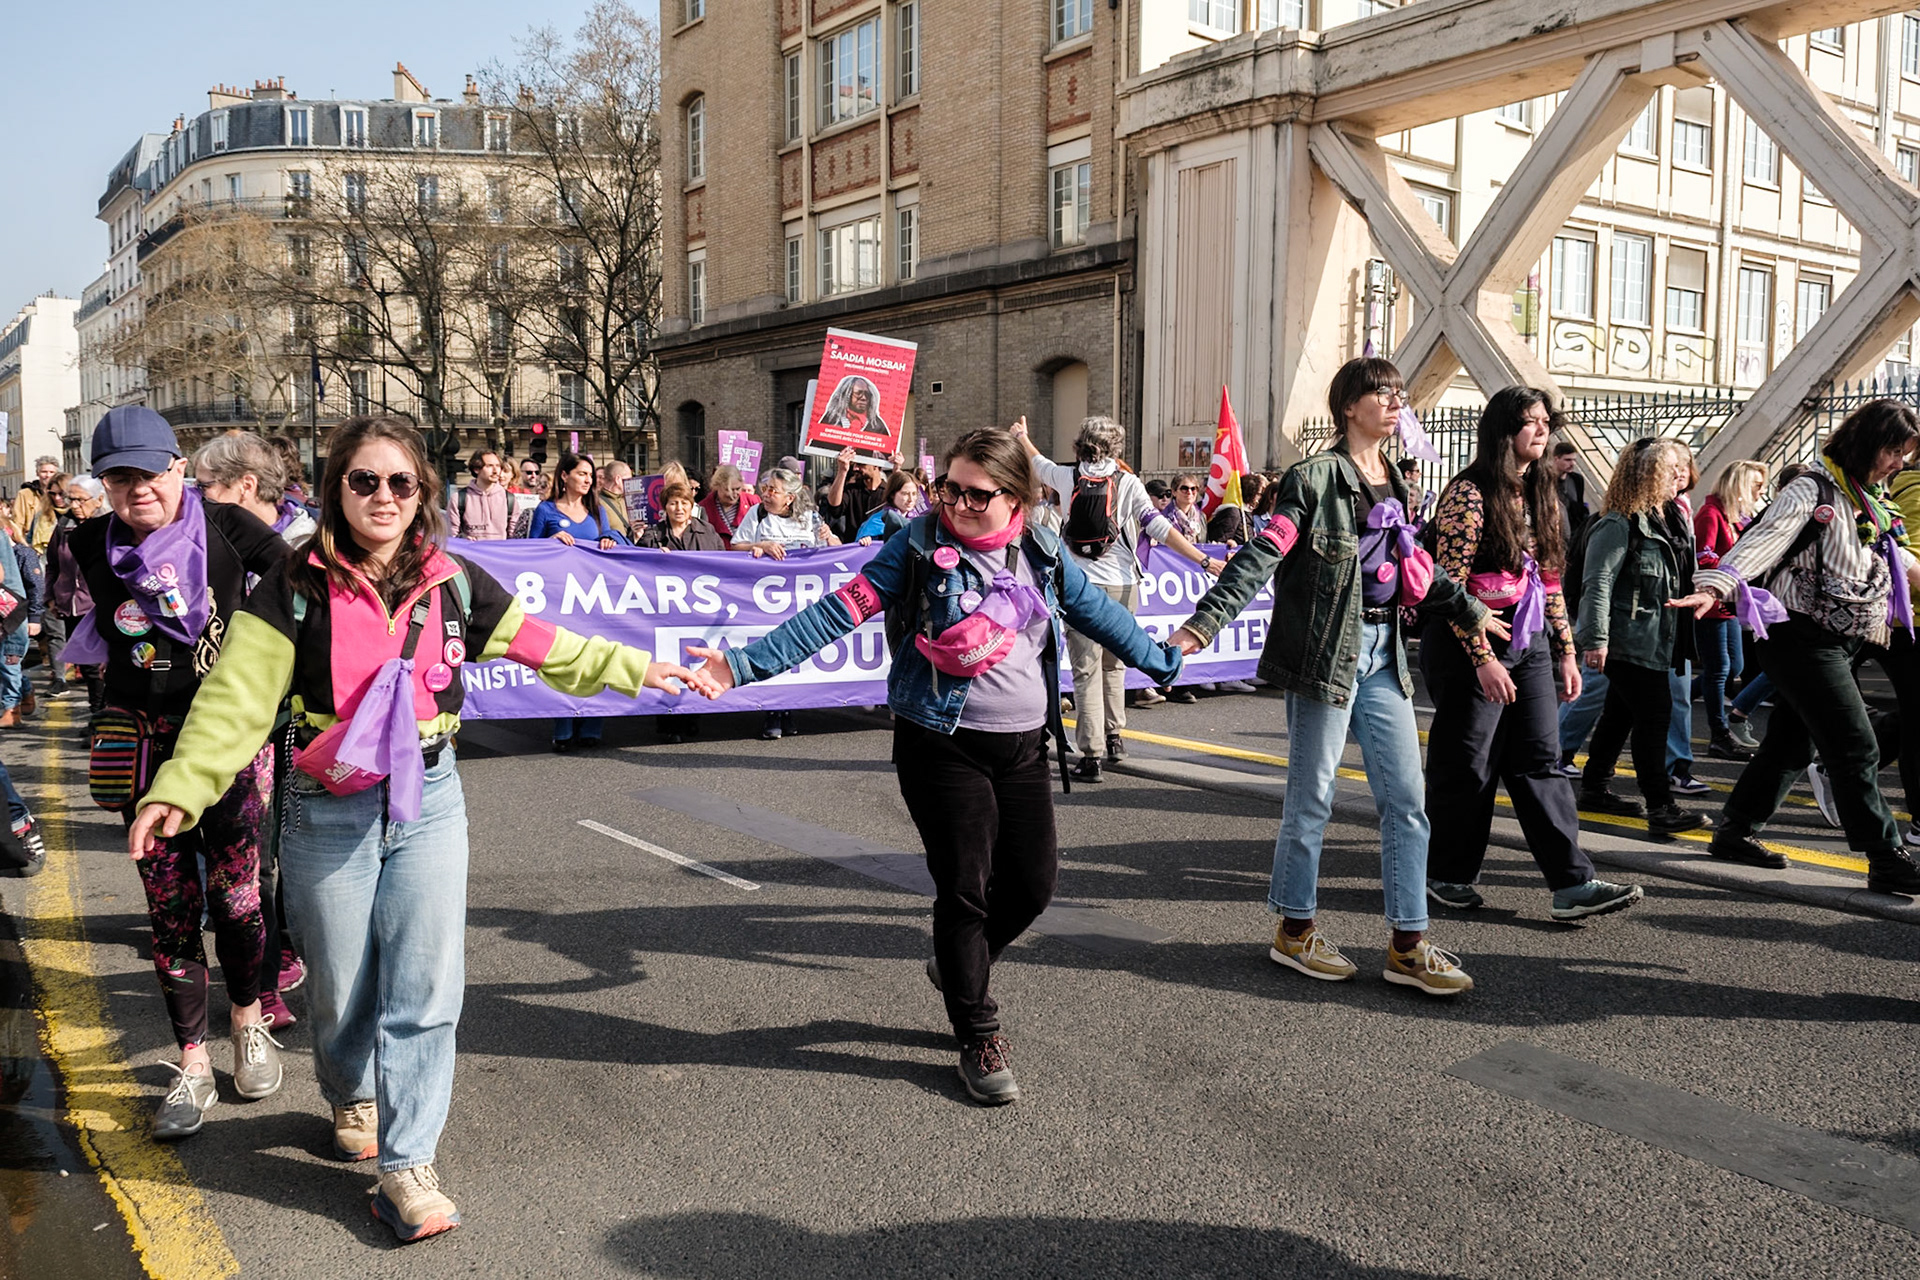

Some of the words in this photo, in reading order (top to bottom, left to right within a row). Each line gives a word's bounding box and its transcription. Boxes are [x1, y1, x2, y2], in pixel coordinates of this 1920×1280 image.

[830, 351, 865, 364] SAADIA
[866, 356, 906, 372] MOSBAH
[515, 572, 547, 614] 8
[560, 572, 739, 619] MARS,
[752, 562, 858, 614] GRÈ
[846, 582, 872, 619] Solida
[463, 663, 536, 692] NISTE
